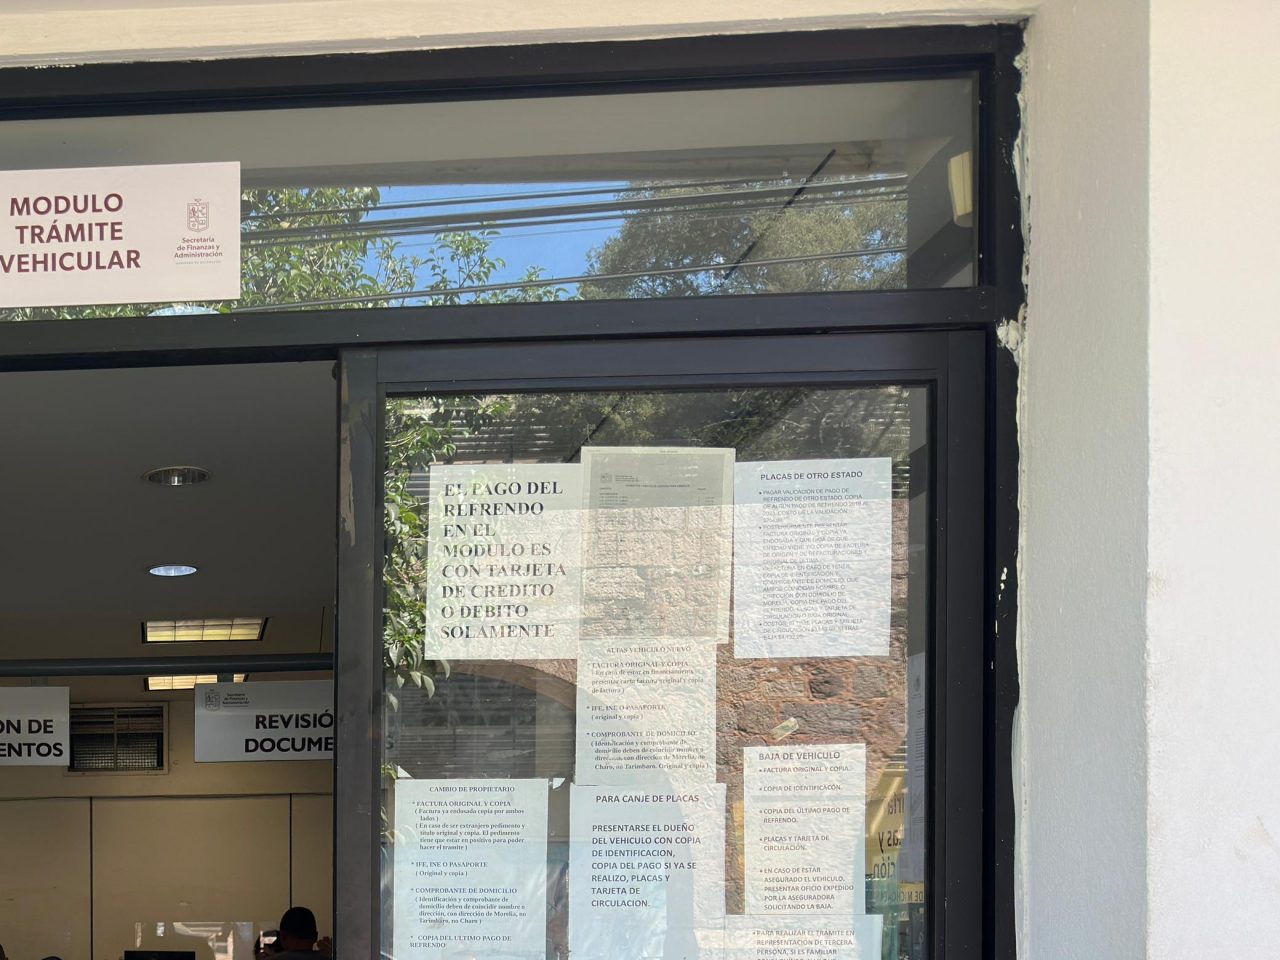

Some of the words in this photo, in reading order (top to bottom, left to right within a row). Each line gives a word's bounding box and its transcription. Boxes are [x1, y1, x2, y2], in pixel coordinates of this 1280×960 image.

[9, 193, 124, 217] MODULO
[15, 219, 124, 245] TRÁMITE
[182, 236, 215, 244] Secretaría
[806, 472, 829, 480] OTRO
[830, 471, 863, 479] ESTADO
[445, 484, 467, 497] EL
[472, 482, 521, 496] PAGO
[527, 482, 563, 495] DEL
[444, 502, 544, 516] REFRENDO
[444, 524, 467, 537] EN
[473, 524, 496, 537] EL
[443, 543, 524, 558] MODULO
[531, 543, 551, 556] ES
[442, 564, 481, 578] CON
[486, 563, 566, 577] TARJETA
[442, 585, 466, 599] DE
[471, 584, 554, 598] CREDITO
[441, 606, 454, 619] O
[460, 604, 529, 618] DEBITO
[441, 625, 555, 639] SOLAMENTE
[27, 719, 54, 734] DE
[759, 753, 780, 761] BAJA
[796, 752, 841, 760] VEHICULO
[596, 795, 620, 803] PARA
[622, 795, 650, 803] CANJE
[652, 794, 664, 802] DE
[666, 794, 700, 802] PLACAS
[797, 806, 821, 814] ÚLTIMO
[652, 824, 661, 832] EL
[664, 822, 695, 832] DUEÑO
[605, 850, 676, 858] IDENTIFICACION,
[592, 862, 617, 870] COPIA
[620, 862, 635, 870] DEL
[638, 862, 662, 870] PAGO
[664, 862, 672, 870] SI
[674, 862, 684, 870] YA
[687, 862, 697, 870] SE
[592, 875, 629, 883] REALIZO,
